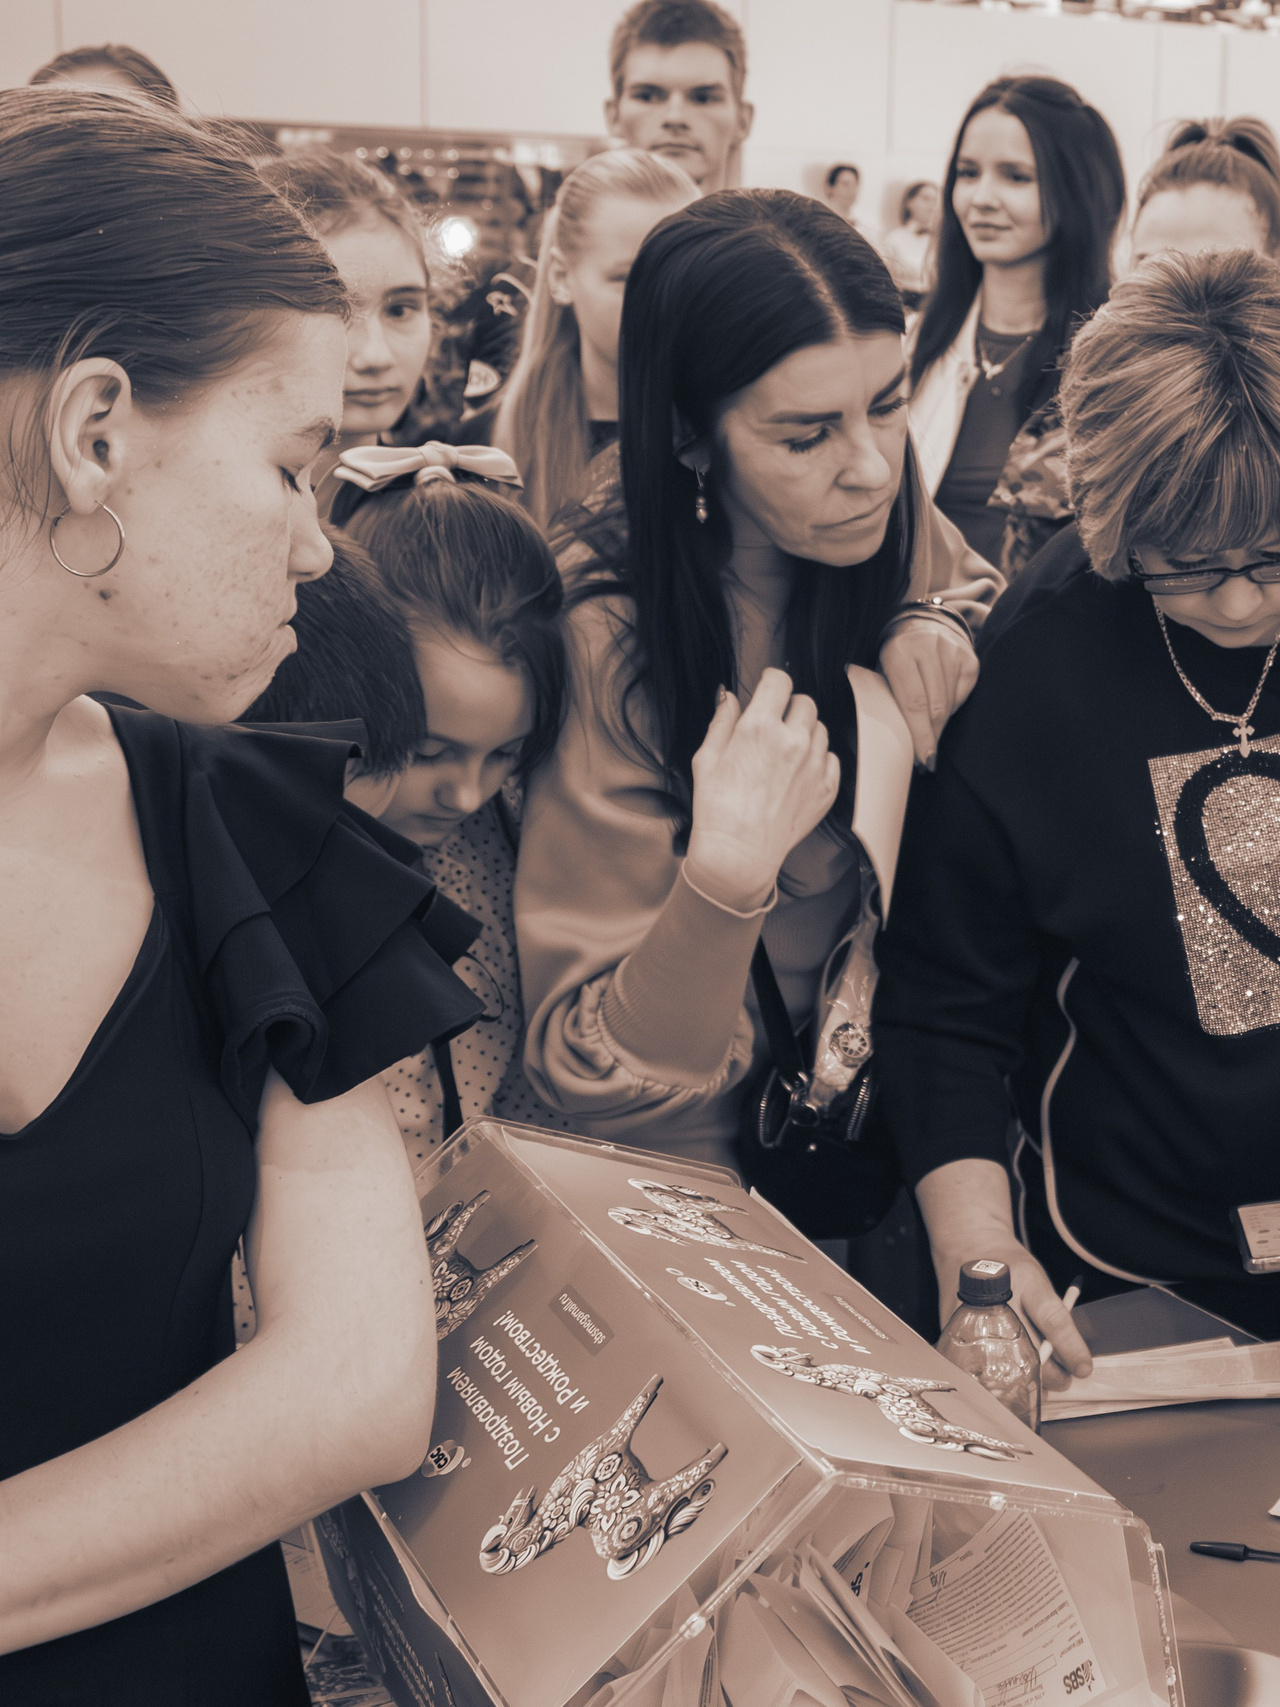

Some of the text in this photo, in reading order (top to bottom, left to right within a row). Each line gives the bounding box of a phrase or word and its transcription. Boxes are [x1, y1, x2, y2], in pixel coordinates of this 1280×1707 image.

[558, 1293, 606, 1345] sbsmegamall.ru
[703, 1257, 804, 1340] Поздравляем
[730, 1259, 839, 1349] с Новым годом
[756, 1265, 872, 1354] и Рождеством!
[469, 1335, 561, 1443] с Новым годом
[492, 1309, 590, 1414] и Рождеством!
[446, 1366, 530, 1471] Поздравляем
[1063, 1666, 1086, 1695] SBS
